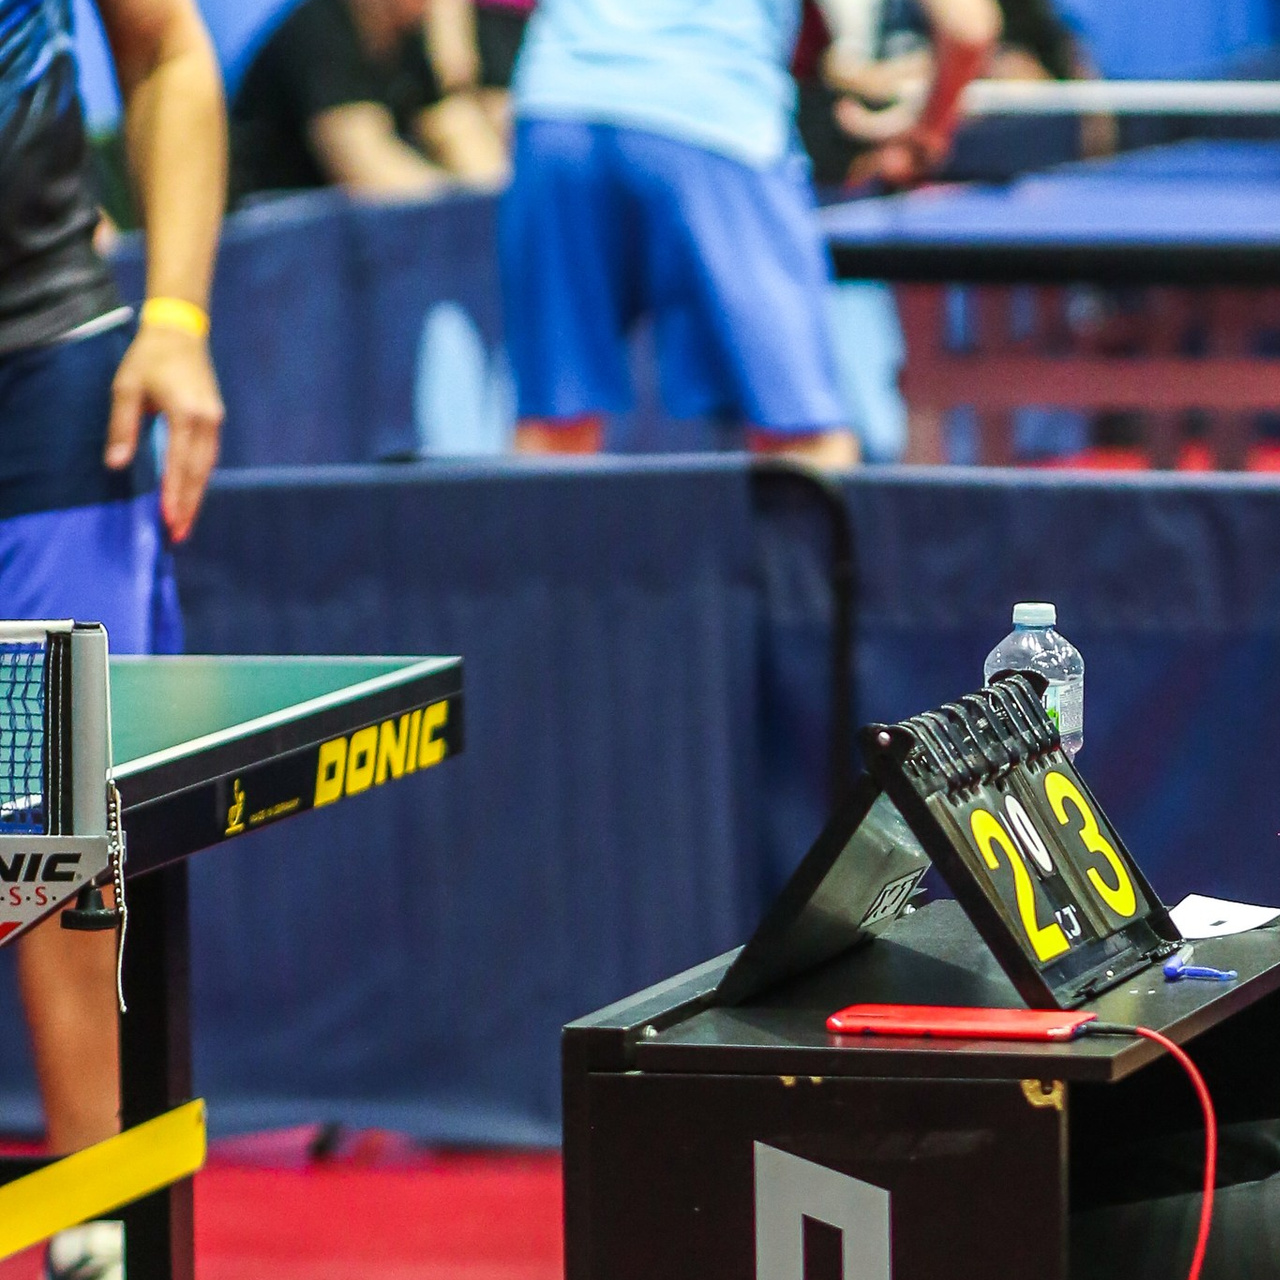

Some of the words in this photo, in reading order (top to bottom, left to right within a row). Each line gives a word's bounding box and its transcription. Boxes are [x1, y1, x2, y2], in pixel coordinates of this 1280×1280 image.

[313, 699, 449, 809] DONIC
[970, 808, 1071, 962] 2
[1044, 771, 1137, 918] 3
